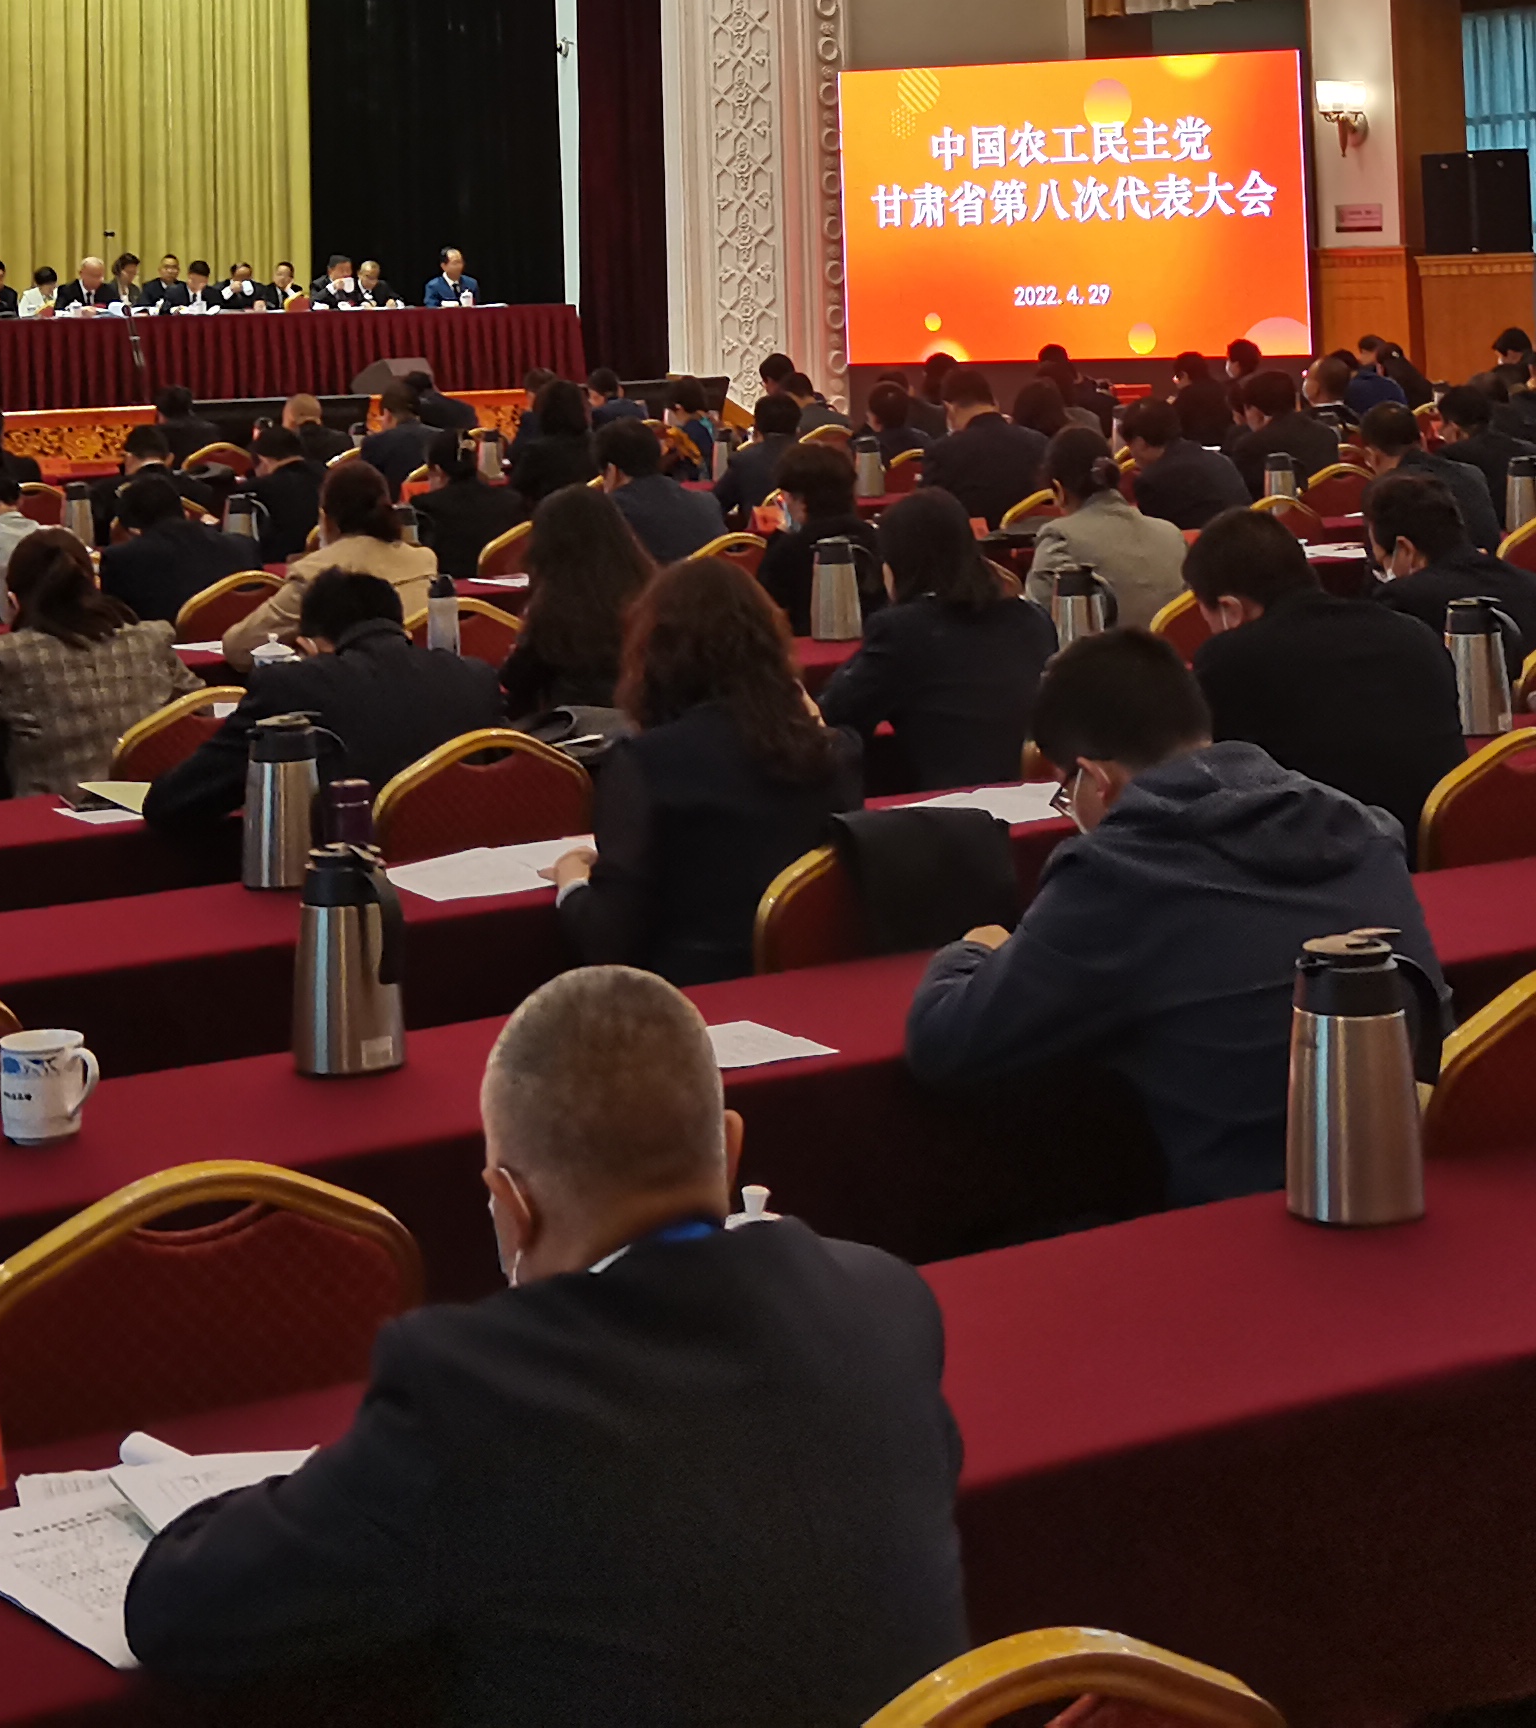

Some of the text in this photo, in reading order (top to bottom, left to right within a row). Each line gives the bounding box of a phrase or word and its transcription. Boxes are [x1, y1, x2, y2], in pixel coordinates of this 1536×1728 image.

[930, 116, 1212, 171] 中国农工民主党
[870, 170, 1278, 229] 甘肃省第八次代表大会
